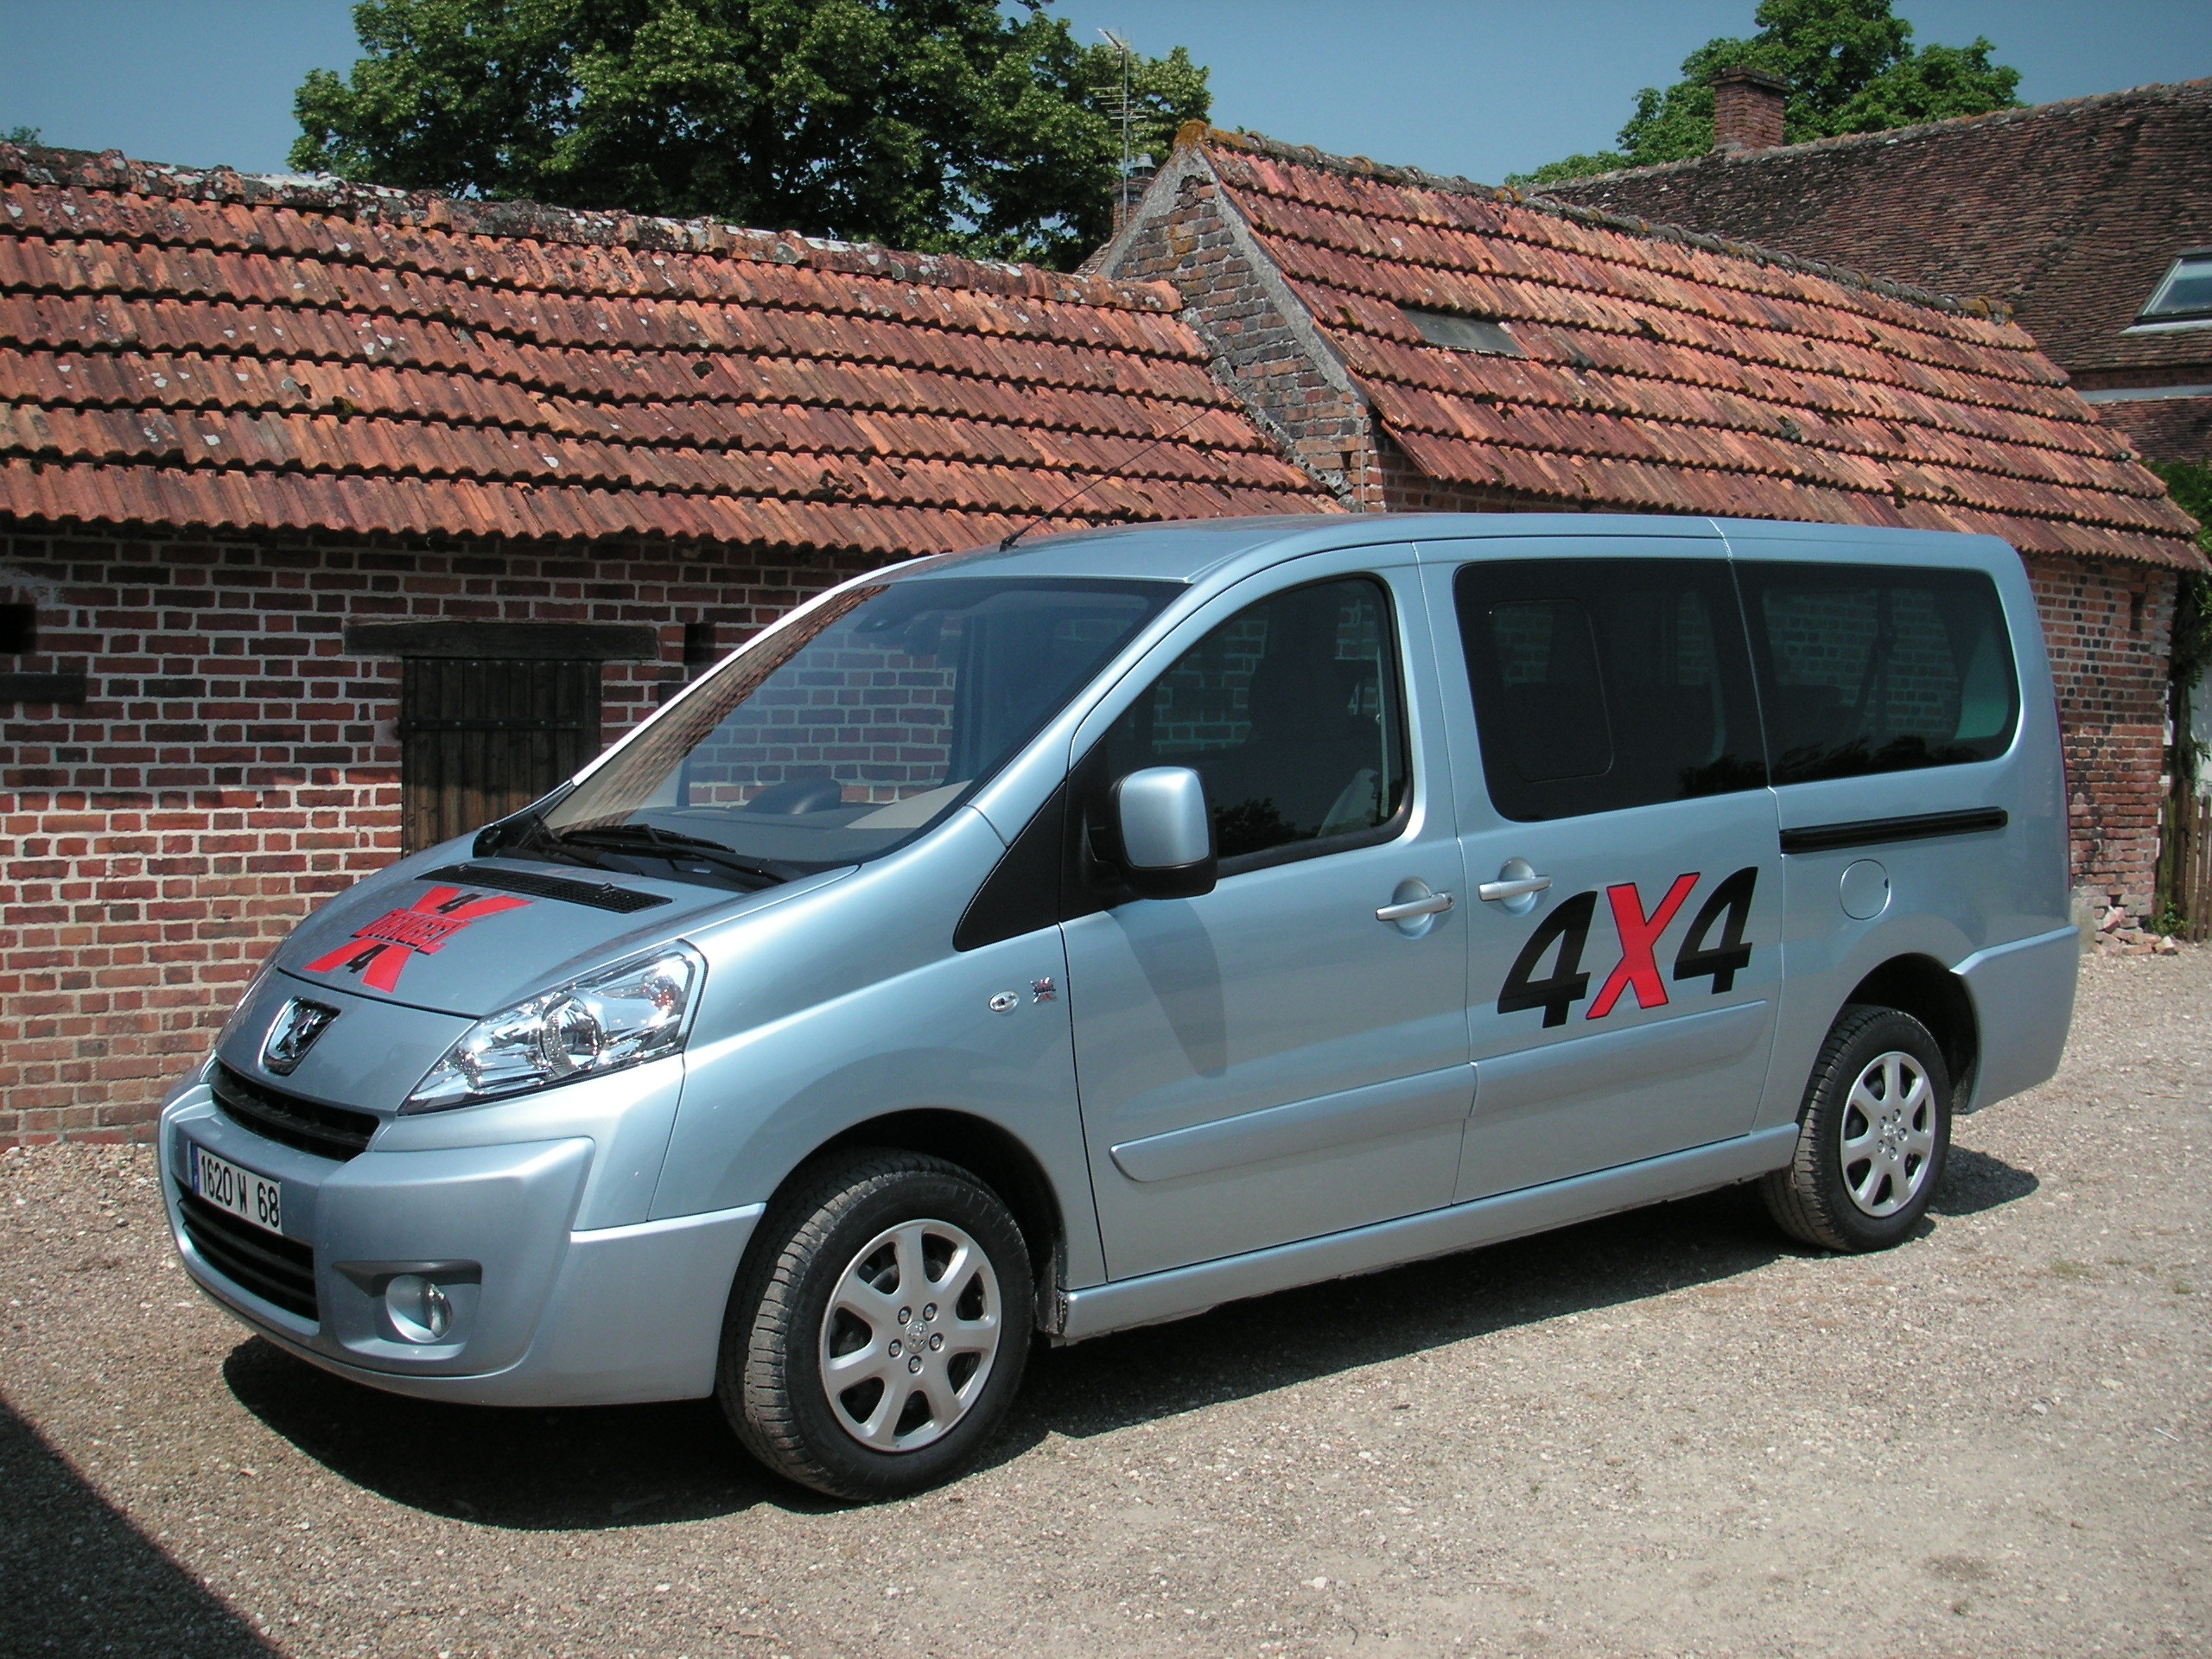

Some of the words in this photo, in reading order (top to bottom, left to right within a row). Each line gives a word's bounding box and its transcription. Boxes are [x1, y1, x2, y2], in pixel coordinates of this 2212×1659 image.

[1497, 866, 1758, 1028] 4X4
[201, 1154, 232, 1207] 1620
[257, 1181, 280, 1228] 68
